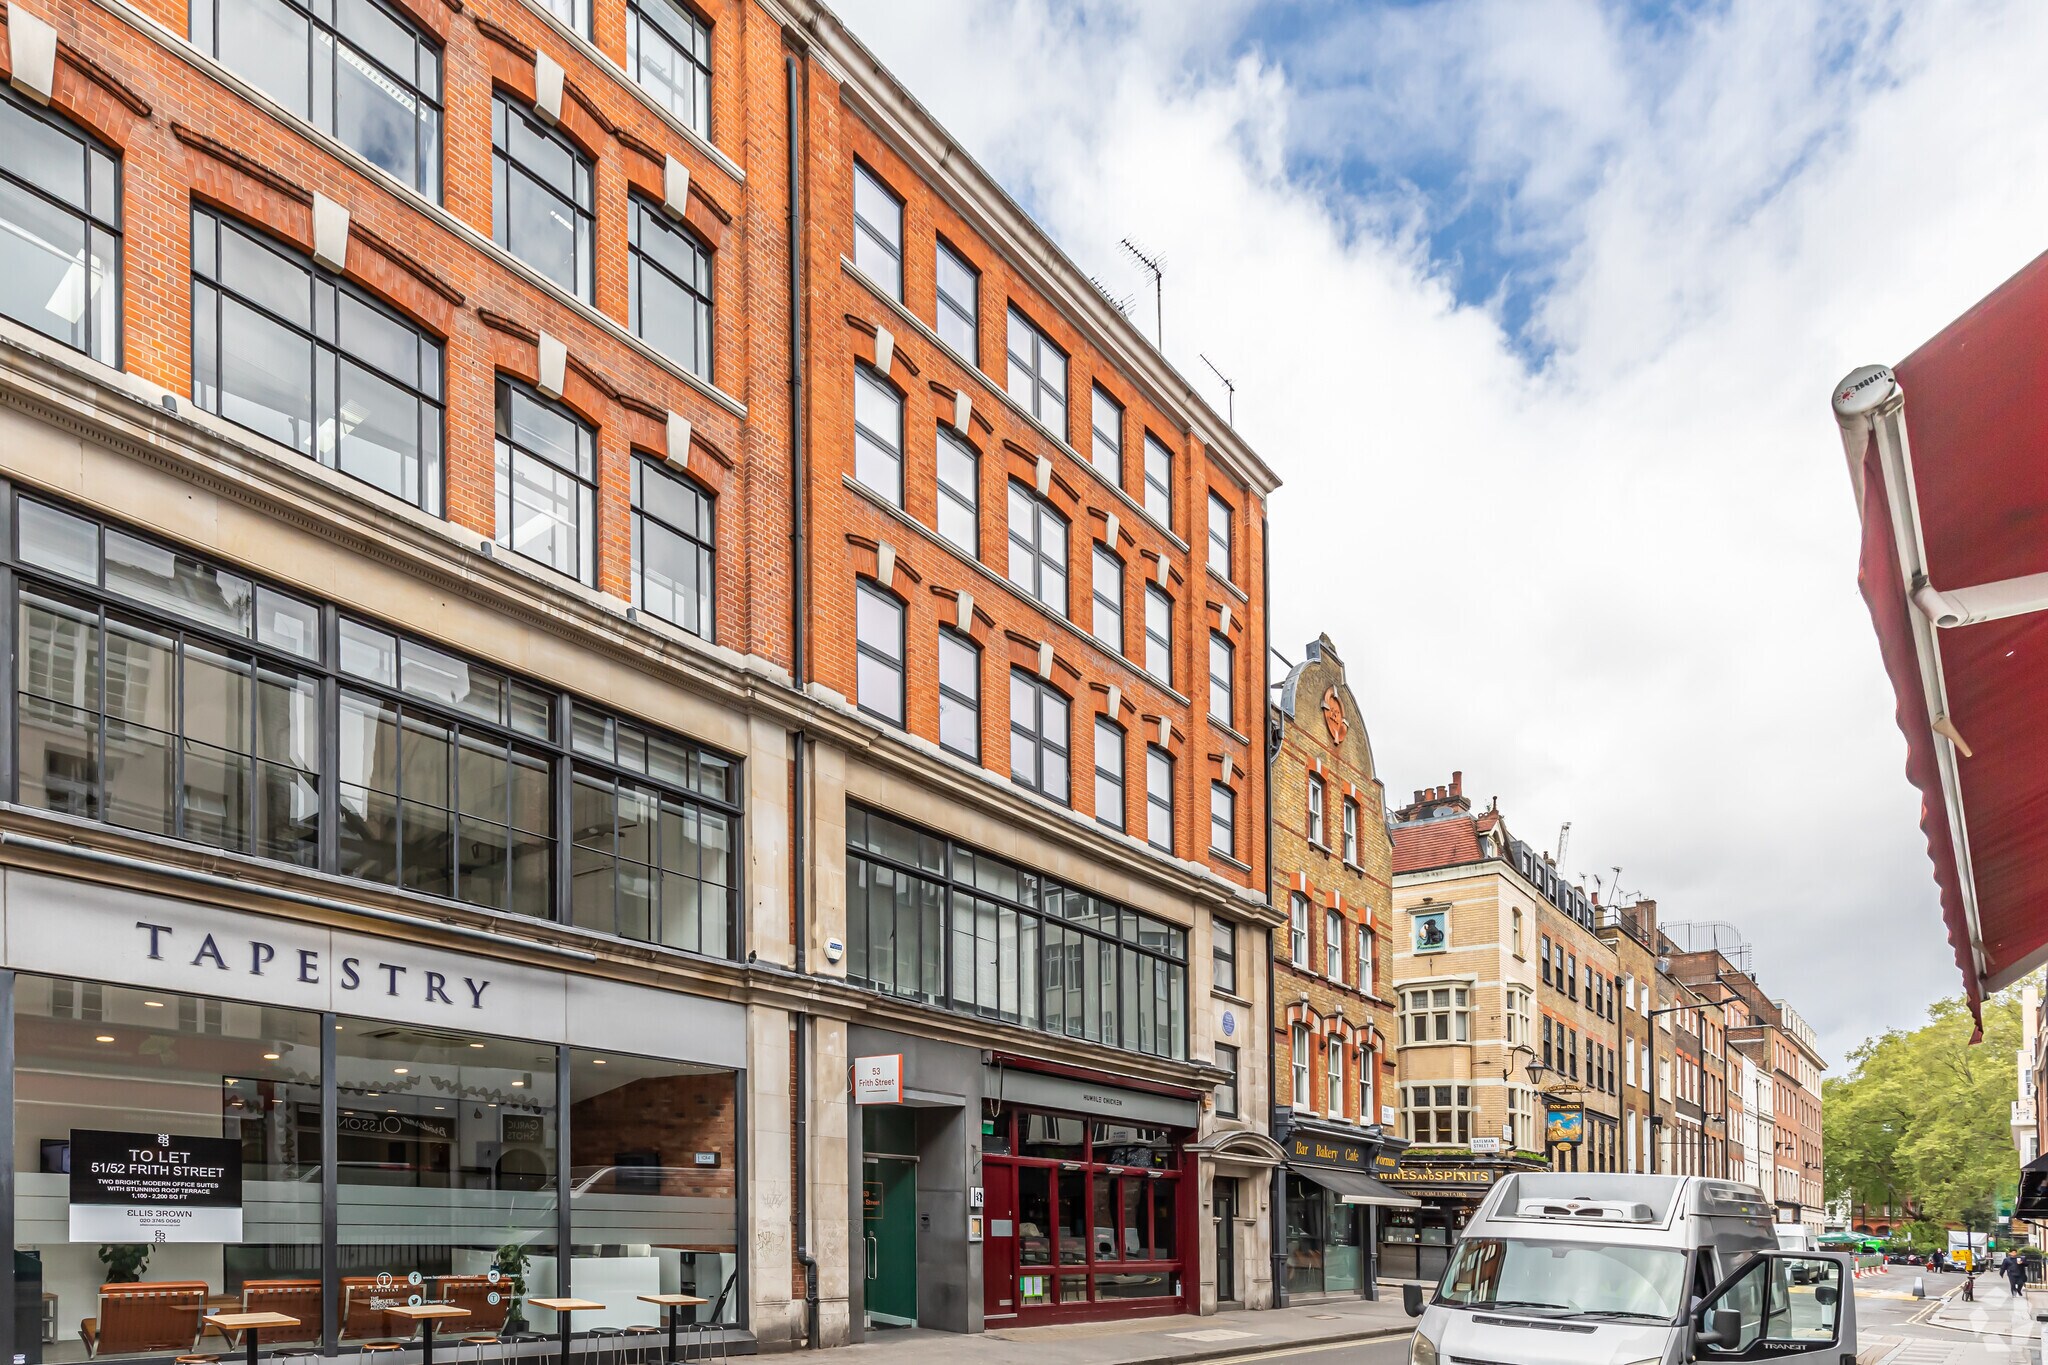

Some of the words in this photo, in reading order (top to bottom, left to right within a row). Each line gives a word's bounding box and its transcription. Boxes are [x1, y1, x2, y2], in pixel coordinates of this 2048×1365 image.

[136, 921, 491, 1009] TAPESTRY
[872, 1067, 881, 1075] 53
[859, 1079, 874, 1087] Frith
[875, 1078, 895, 1086] Street
[129, 1149, 153, 1162] TO
[159, 1151, 191, 1164] LET
[1296, 1141, 1309, 1155] Bar
[1316, 1144, 1338, 1162] Bakery
[91, 1162, 125, 1174] 51/52
[129, 1164, 169, 1176] FRITH
[173, 1166, 225, 1178] STREET
[1379, 1170, 1417, 1181] WINES
[1417, 1173, 1434, 1181] AND
[1435, 1170, 1489, 1181] SPIRITS
[1763, 1343, 1807, 1351] TRANSIT
